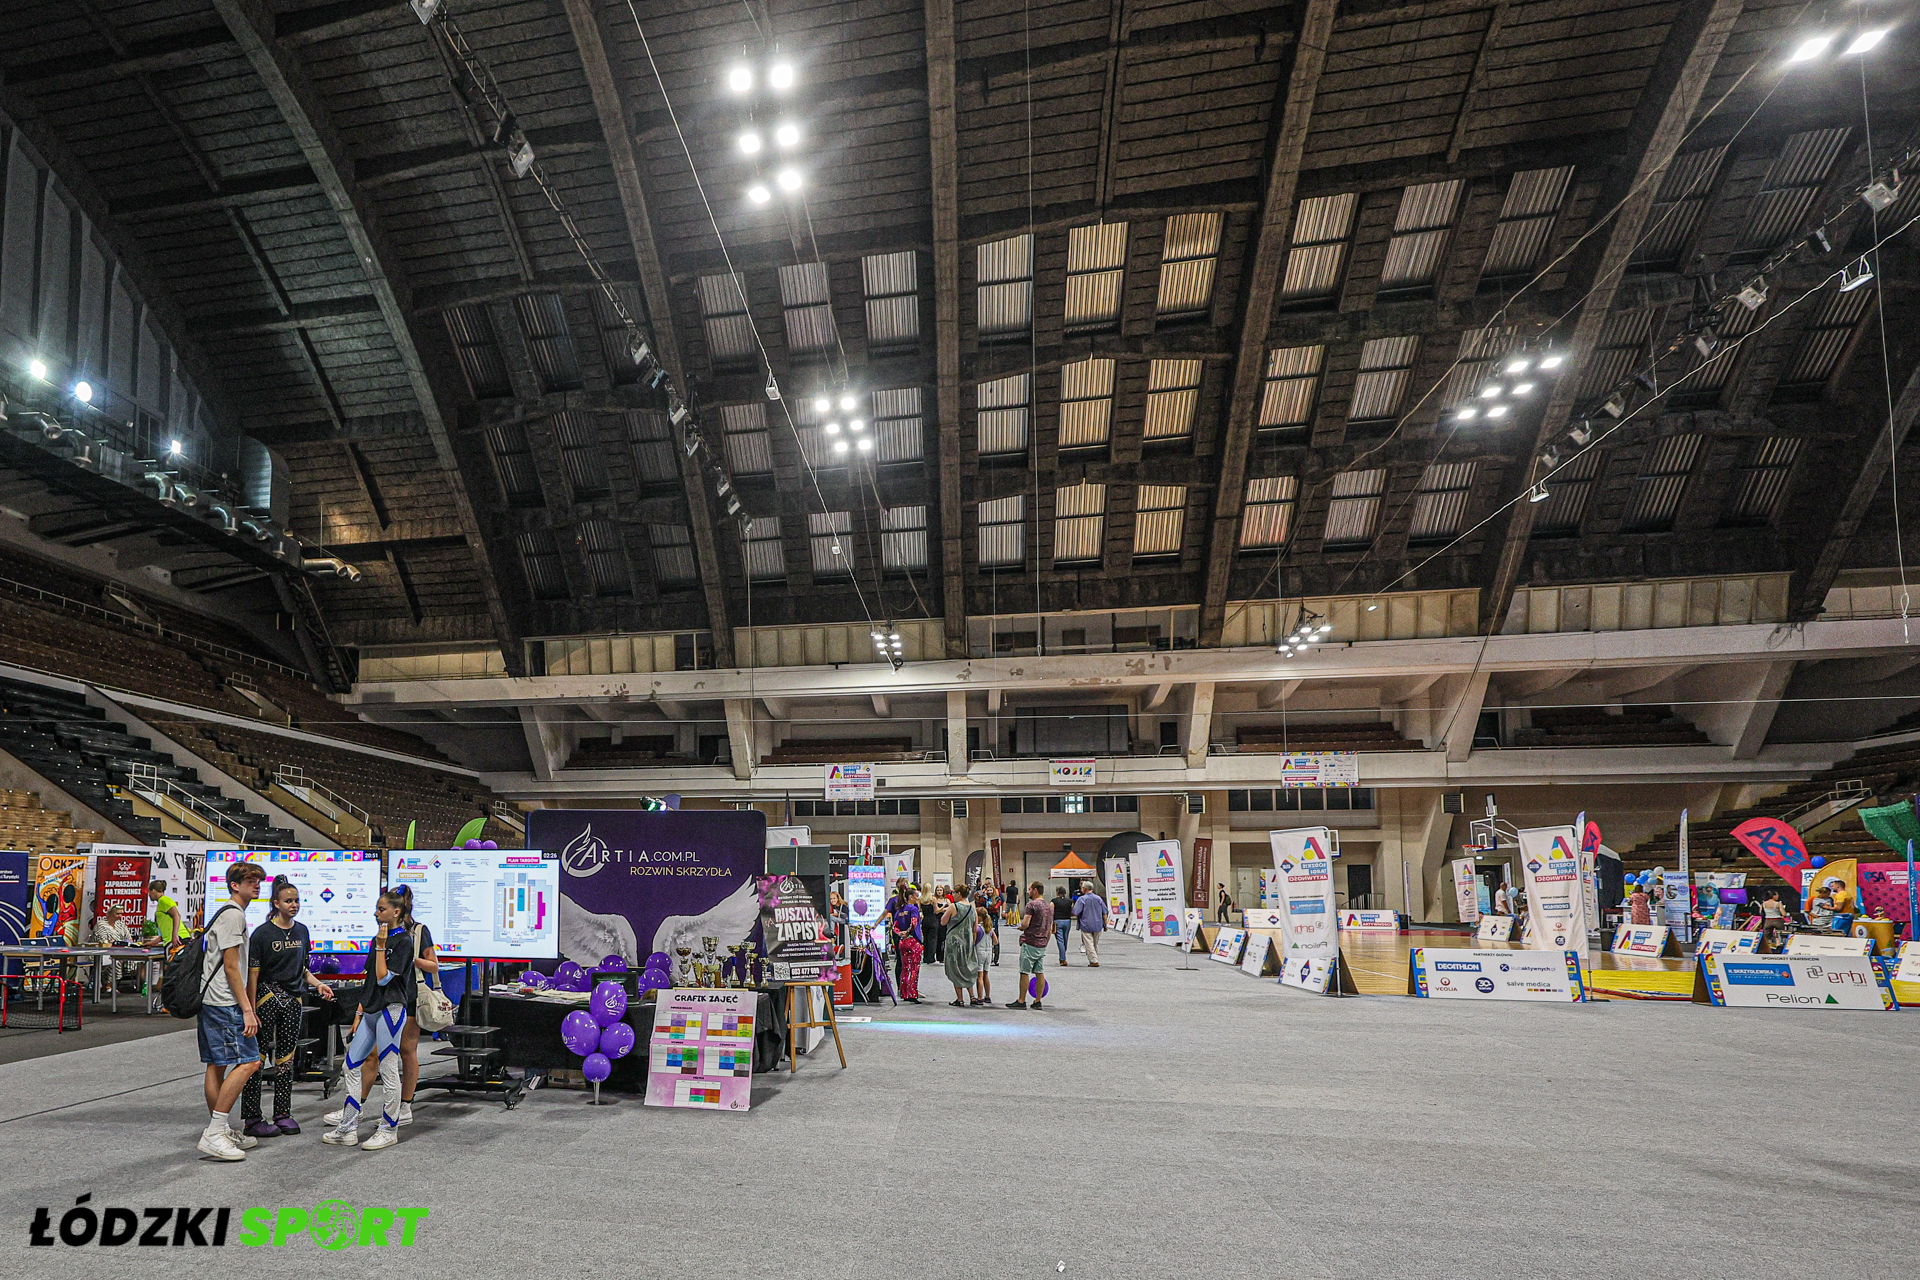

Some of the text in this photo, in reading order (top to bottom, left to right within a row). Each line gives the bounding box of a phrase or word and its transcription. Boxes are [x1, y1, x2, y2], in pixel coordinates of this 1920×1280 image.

[630, 865, 732, 877] ROZWIŃ SKRZYDŁA
[104, 880, 143, 888] ZAPRASZAMY
[105, 888, 114, 896] NA
[774, 906, 816, 922] RUSZYŁY
[775, 921, 819, 942] ZAPISY
[1437, 963, 1480, 971] DECATHLON
[1827, 969, 1867, 985] erbi
[674, 994, 739, 1004] GRAFIK ZAJĘĆ
[1766, 993, 1821, 1004] Pelion
